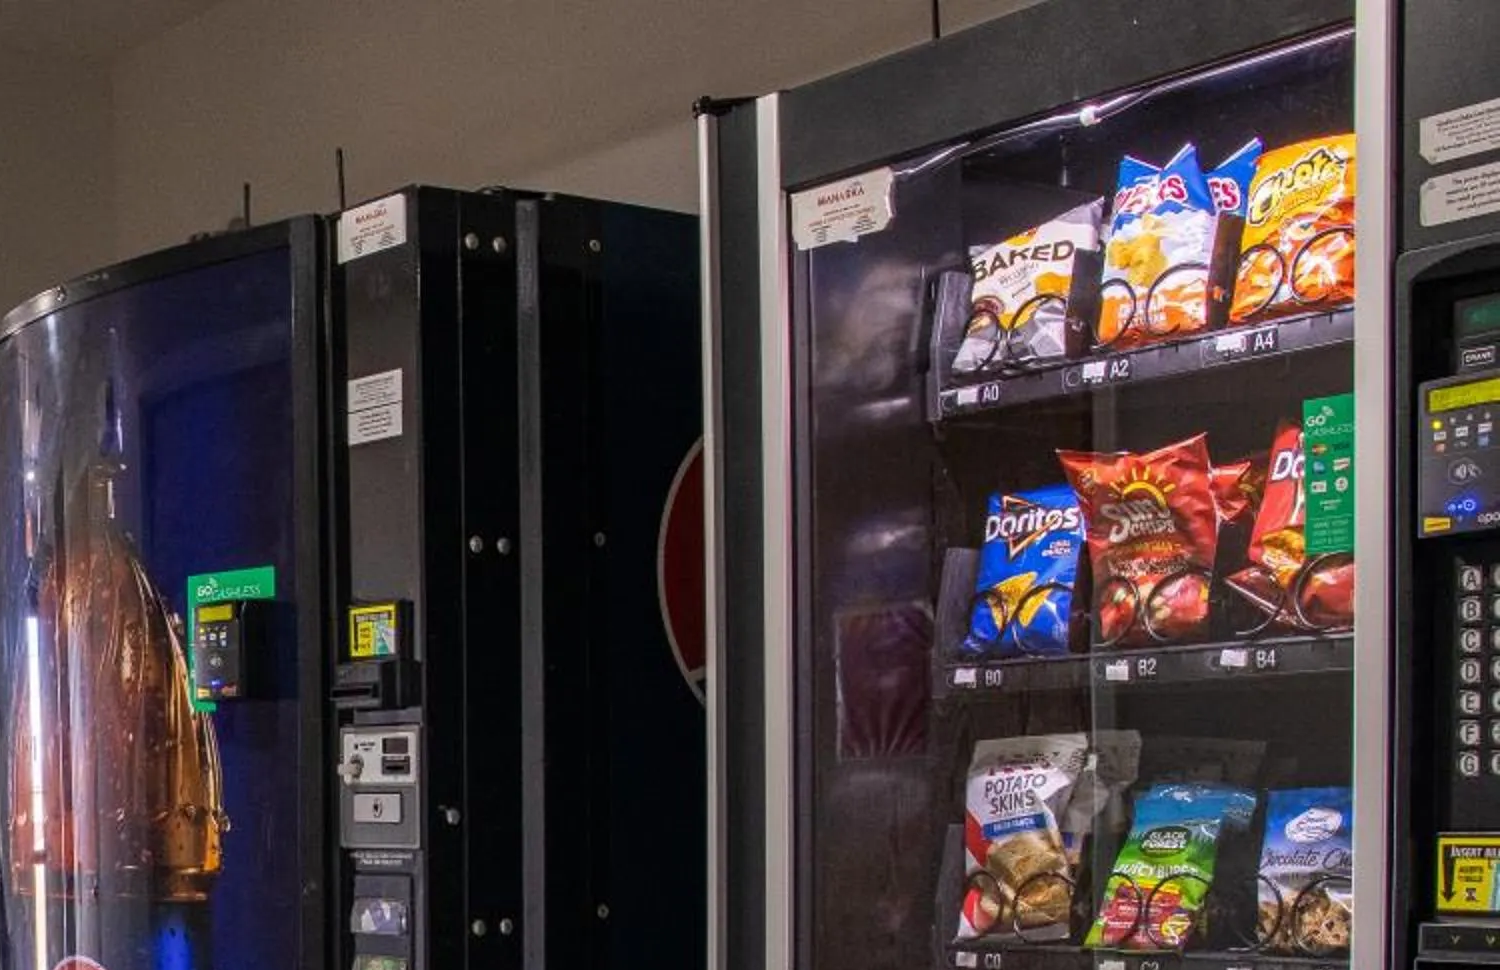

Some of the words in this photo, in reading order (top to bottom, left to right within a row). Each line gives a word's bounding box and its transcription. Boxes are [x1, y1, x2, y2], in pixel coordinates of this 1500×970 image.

[972, 239, 1075, 282] BAKED
[1254, 332, 1275, 350] A4
[1111, 359, 1130, 378] A2
[982, 385, 999, 402] A0
[1306, 415, 1326, 427] GO
[985, 506, 1080, 543] Doritos
[985, 773, 1047, 799] POTATO
[990, 789, 1036, 815] SKINS
[985, 953, 1001, 969] C0
